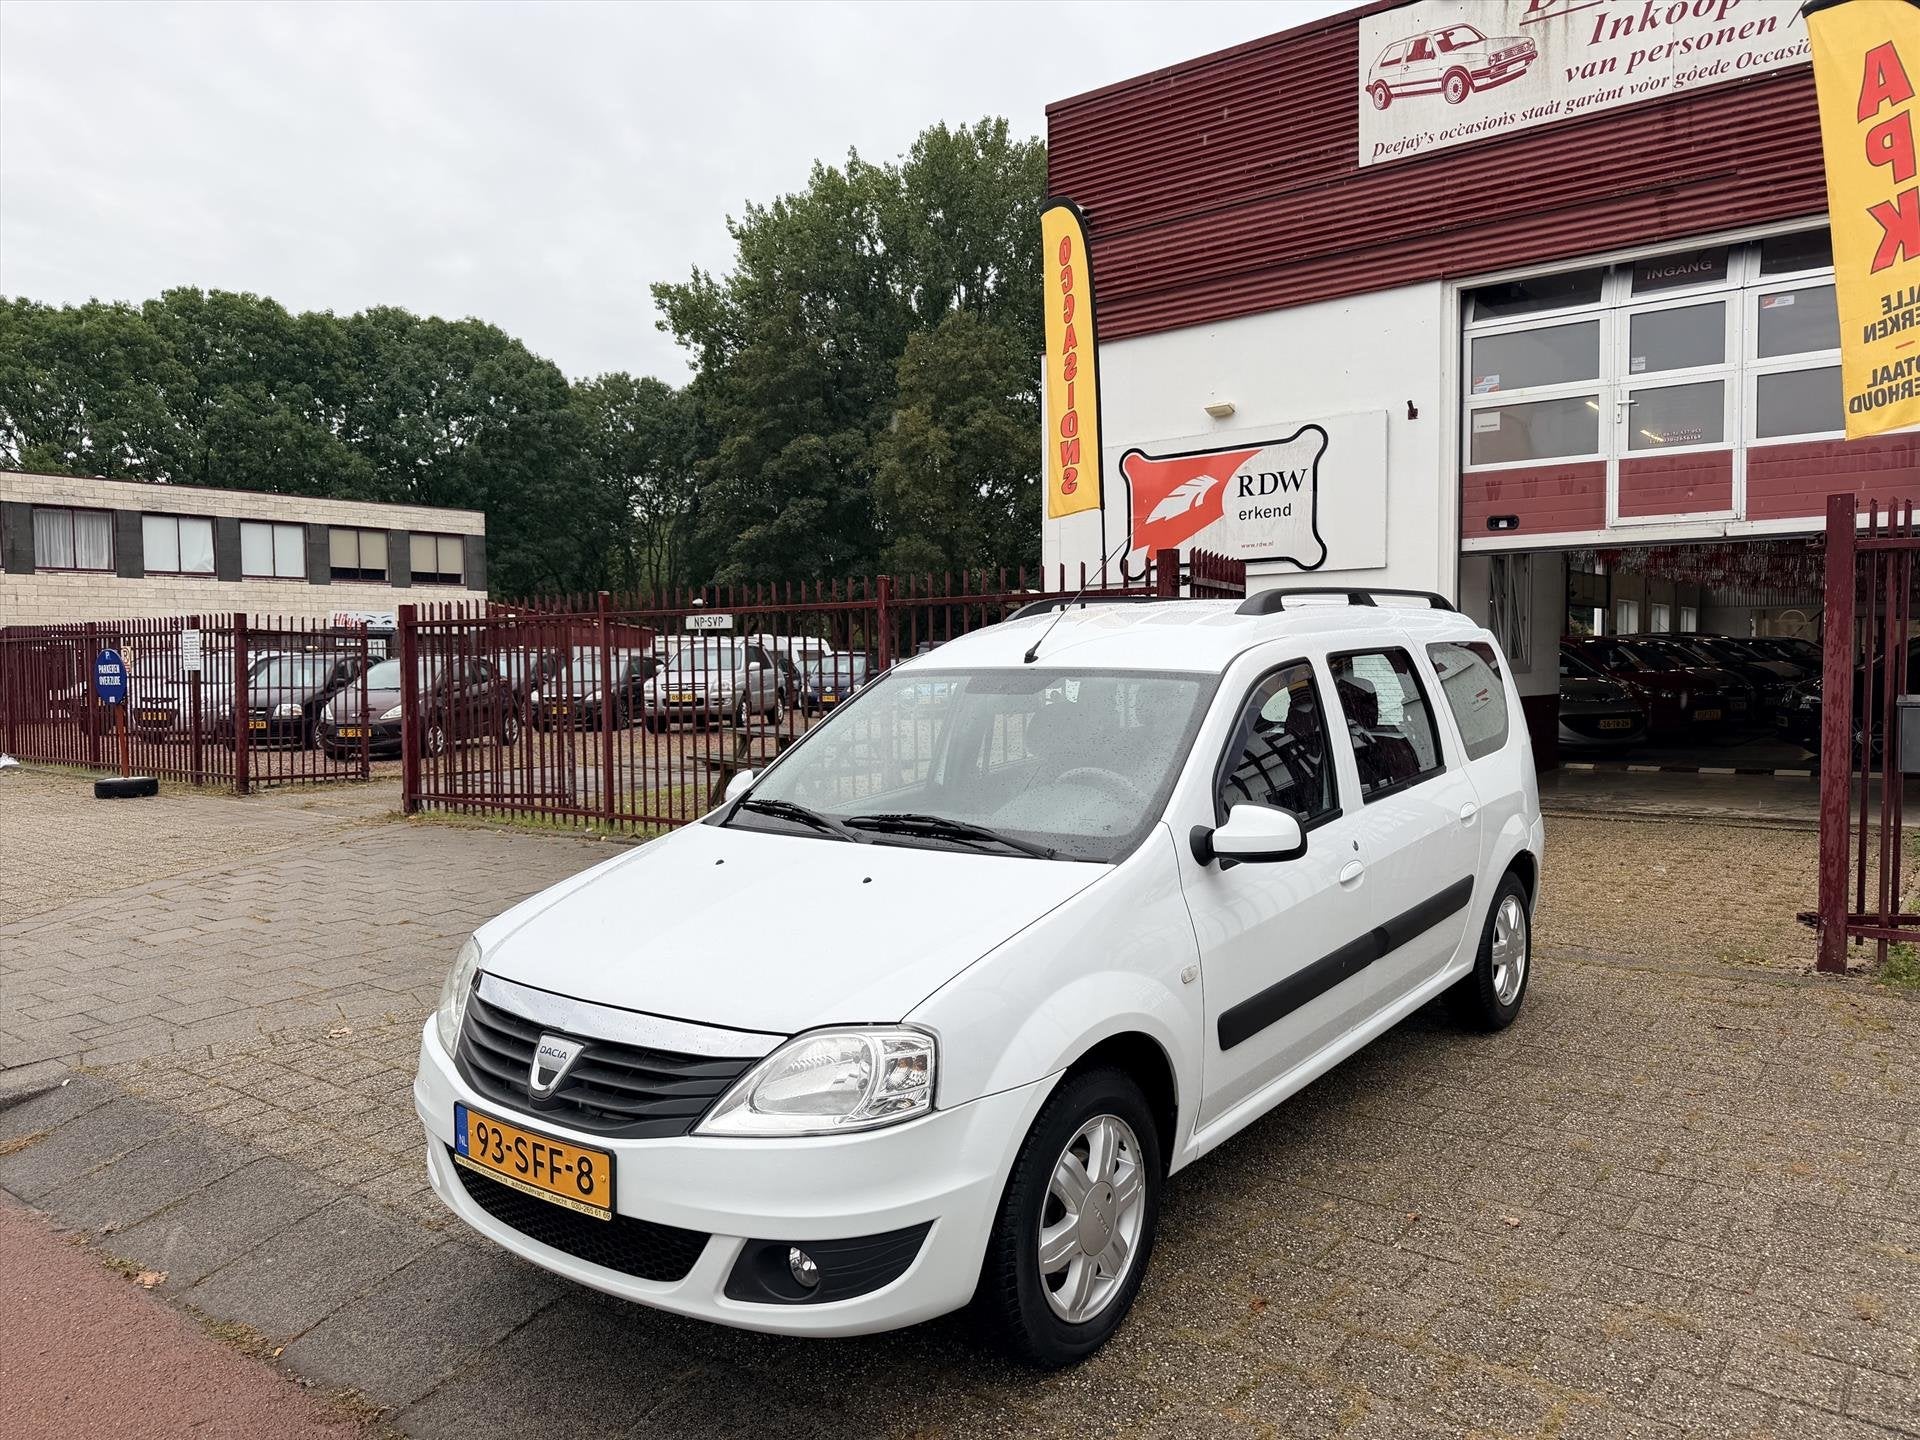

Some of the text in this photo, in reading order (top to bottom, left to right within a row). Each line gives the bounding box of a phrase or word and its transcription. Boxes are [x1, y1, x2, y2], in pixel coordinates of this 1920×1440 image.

[1565, 57, 1618, 83] van
[1625, 15, 1778, 75] personen
[1373, 38, 1813, 157] Deejay's occasions staat garant voor goede Occasio
[1646, 260, 1713, 280] INGANG
[1237, 468, 1308, 498] RDW
[1239, 503, 1291, 520] erkend
[694, 616, 724, 627] NP-SVP
[98, 664, 120, 674] PARKEREN
[540, 1045, 567, 1060] DACIA
[458, 1135, 468, 1148] NL
[476, 1121, 594, 1195] 93-SFF-8
